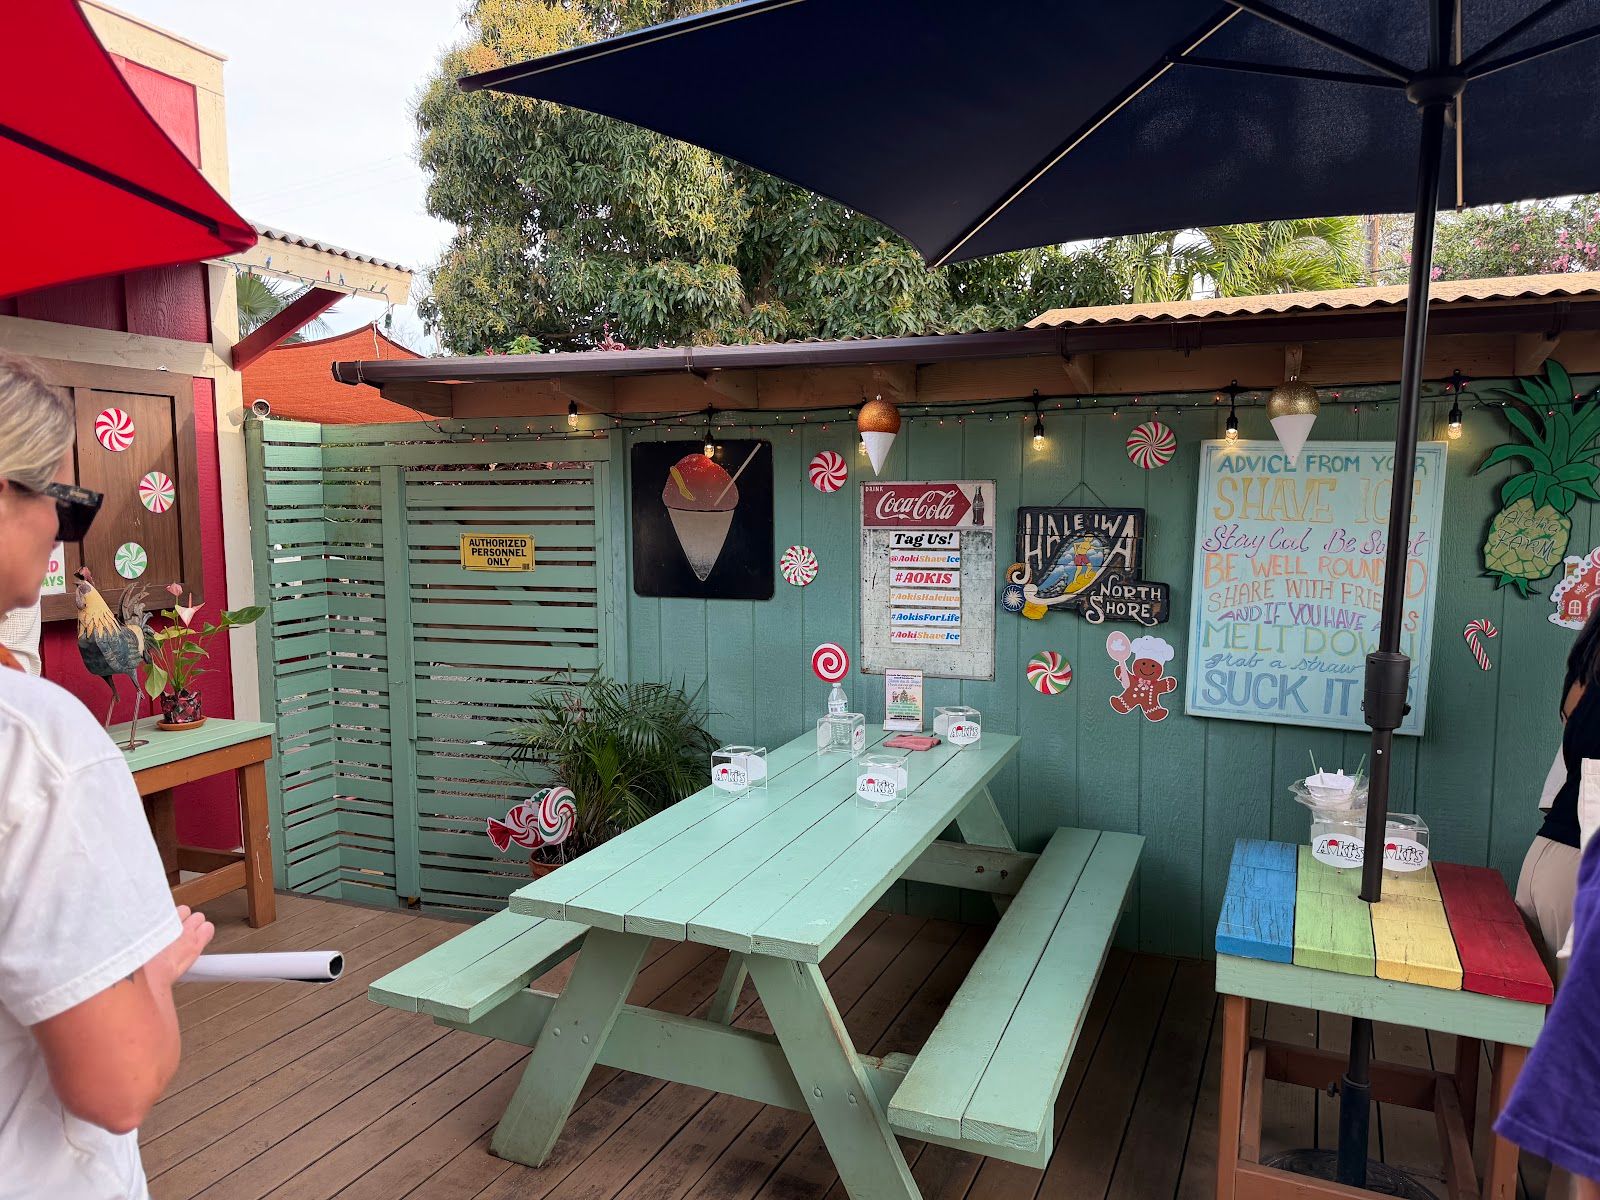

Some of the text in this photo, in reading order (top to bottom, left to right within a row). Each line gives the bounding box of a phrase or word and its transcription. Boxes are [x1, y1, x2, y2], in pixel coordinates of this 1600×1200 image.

[1217, 454, 1297, 474] ADVICE
[1306, 454, 1360, 474] FROM
[875, 489, 959, 520] Coca-Cola
[1213, 476, 1337, 524] SHAVE
[469, 538, 527, 548] AUTHORIZED
[894, 532, 954, 548] Tag Us!
[1201, 523, 1267, 559] Stay
[1323, 528, 1357, 554] Be
[471, 547, 527, 557] PERSONNEL
[487, 557, 511, 567] ONLY
[889, 554, 961, 563] @AokiShaveIce
[895, 571, 953, 585] #AOKIS
[1204, 552, 1428, 600] BE WELL ROUNDD
[890, 592, 961, 602] #AokisHaleiwa
[1101, 575, 1161, 601] NORTH
[1207, 579, 1276, 613] SHARE
[1285, 578, 1335, 600] WITH
[891, 612, 961, 622] #AokisForLife
[1086, 590, 1158, 626] SHORE
[1216, 604, 1263, 622] AND
[1263, 601, 1287, 625] IF
[1287, 601, 1321, 628] YOU
[1323, 605, 1367, 632] HAVE
[890, 631, 961, 640] #AokiShaveIce
[1202, 620, 1295, 653] MELT
[1204, 652, 1366, 675] grab a straw
[1201, 669, 1310, 714] SUCK
[1322, 677, 1360, 717] IT
